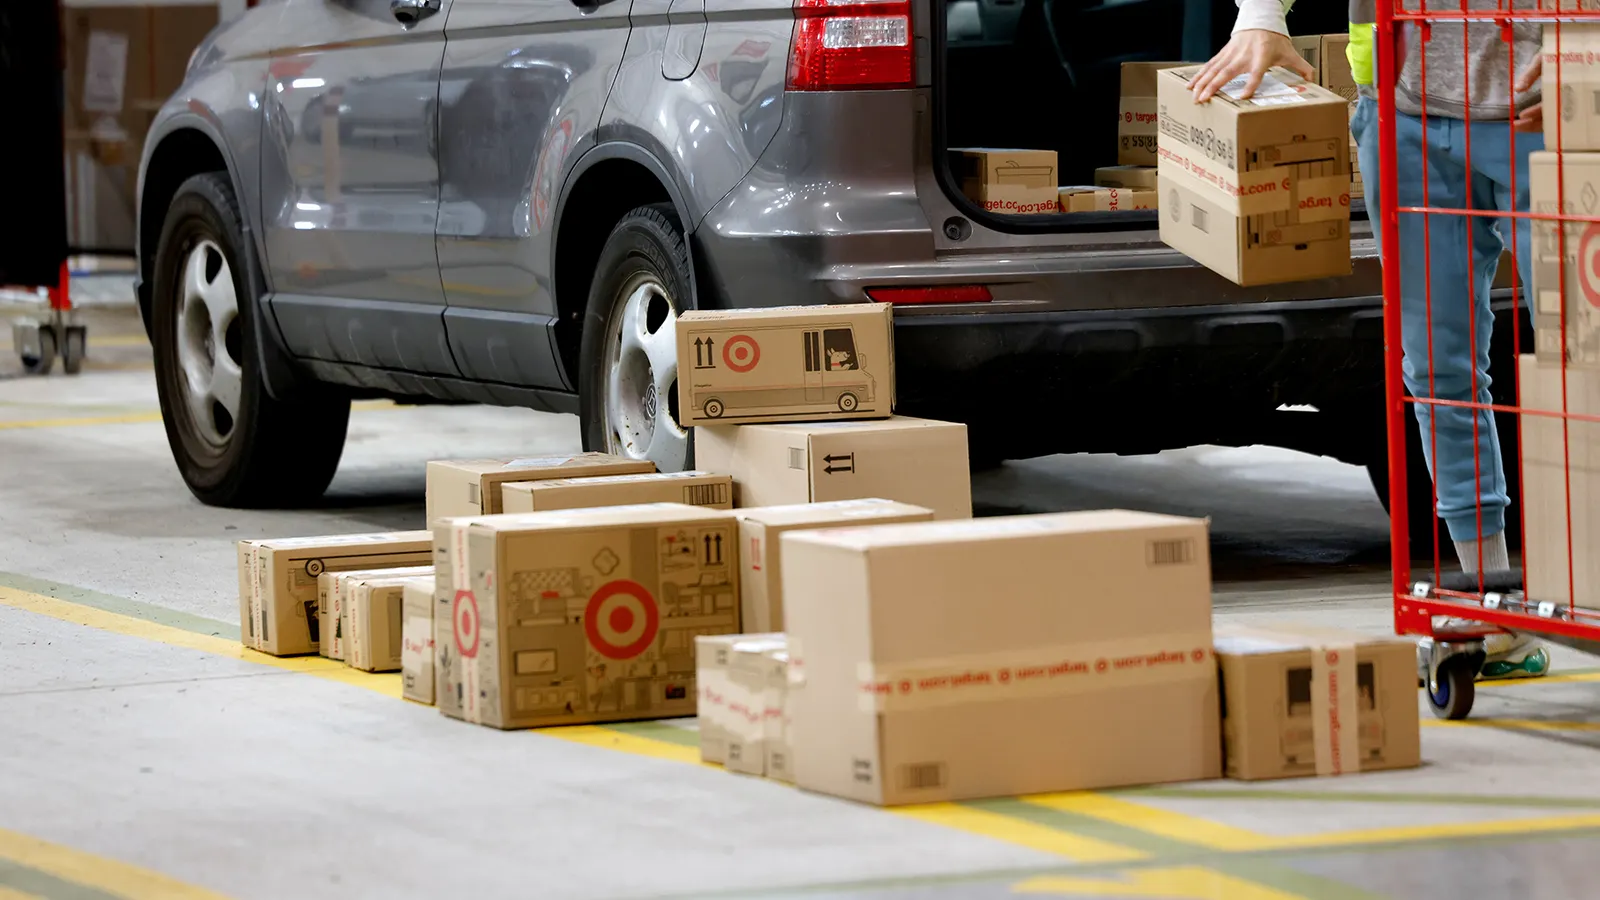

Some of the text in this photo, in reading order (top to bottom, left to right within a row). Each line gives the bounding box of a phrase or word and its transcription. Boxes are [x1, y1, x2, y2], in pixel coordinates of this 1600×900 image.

[918, 650, 1186, 688] target.com target.com target.com
